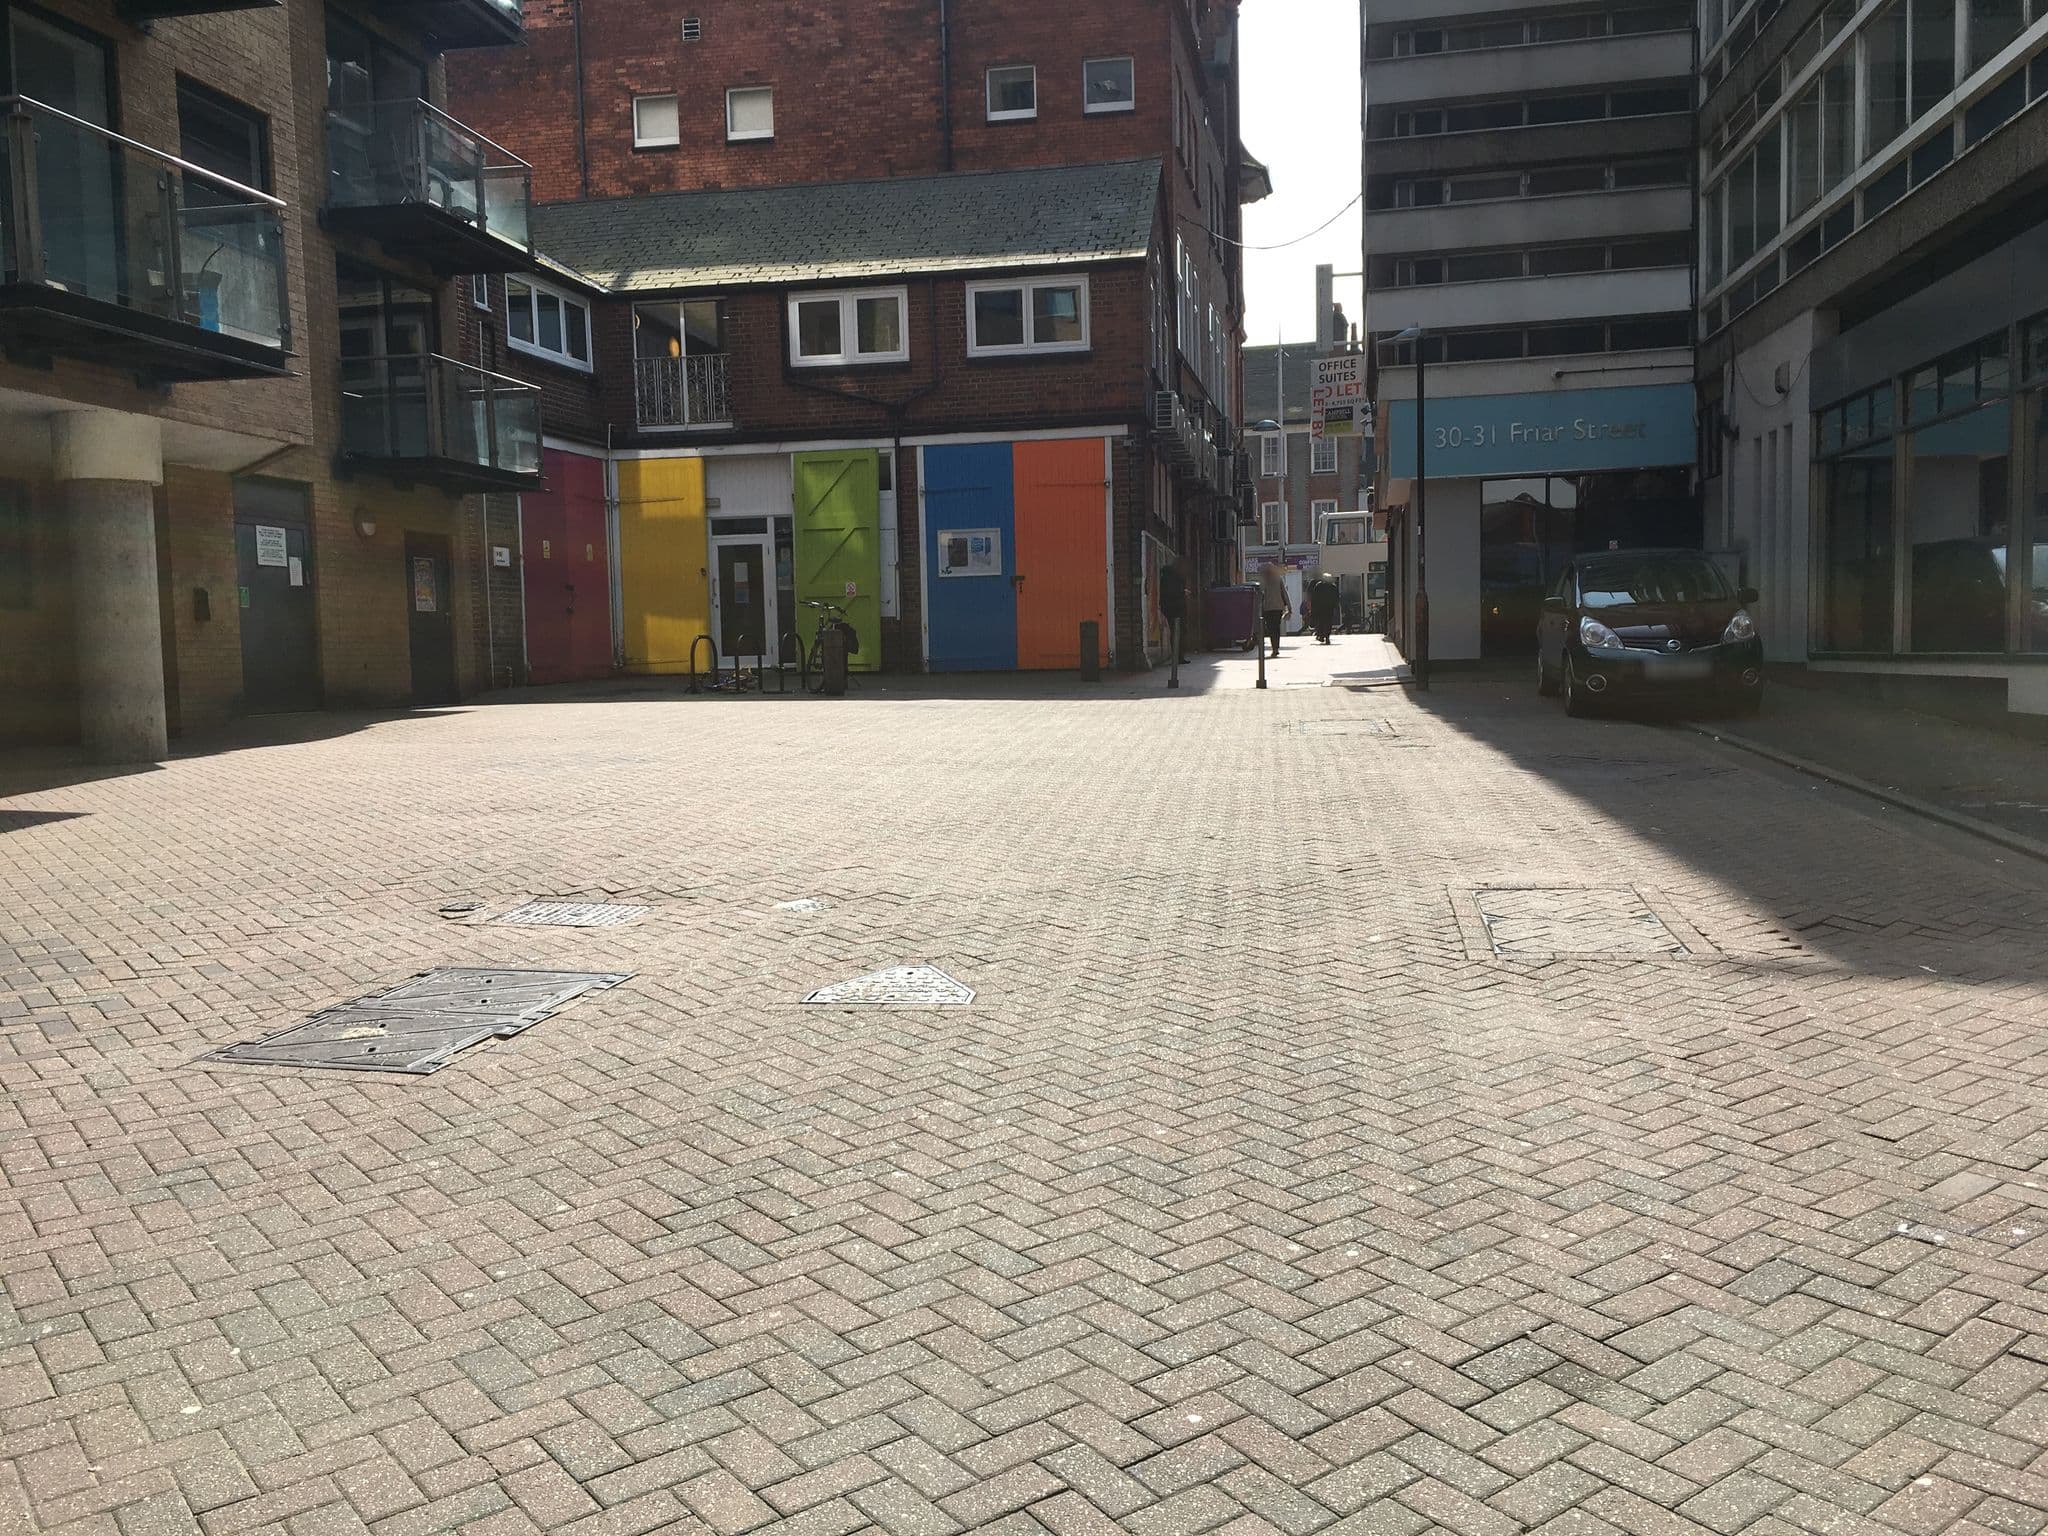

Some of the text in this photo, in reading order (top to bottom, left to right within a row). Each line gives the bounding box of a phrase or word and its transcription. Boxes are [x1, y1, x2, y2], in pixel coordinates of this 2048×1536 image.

[1318, 359, 1357, 372] OFFICE
[1319, 370, 1356, 384] SUITES
[1336, 383, 1362, 397] LET
[1312, 390, 1324, 440] LET BY
[1434, 418, 1648, 448] 30-31 Friar Street
